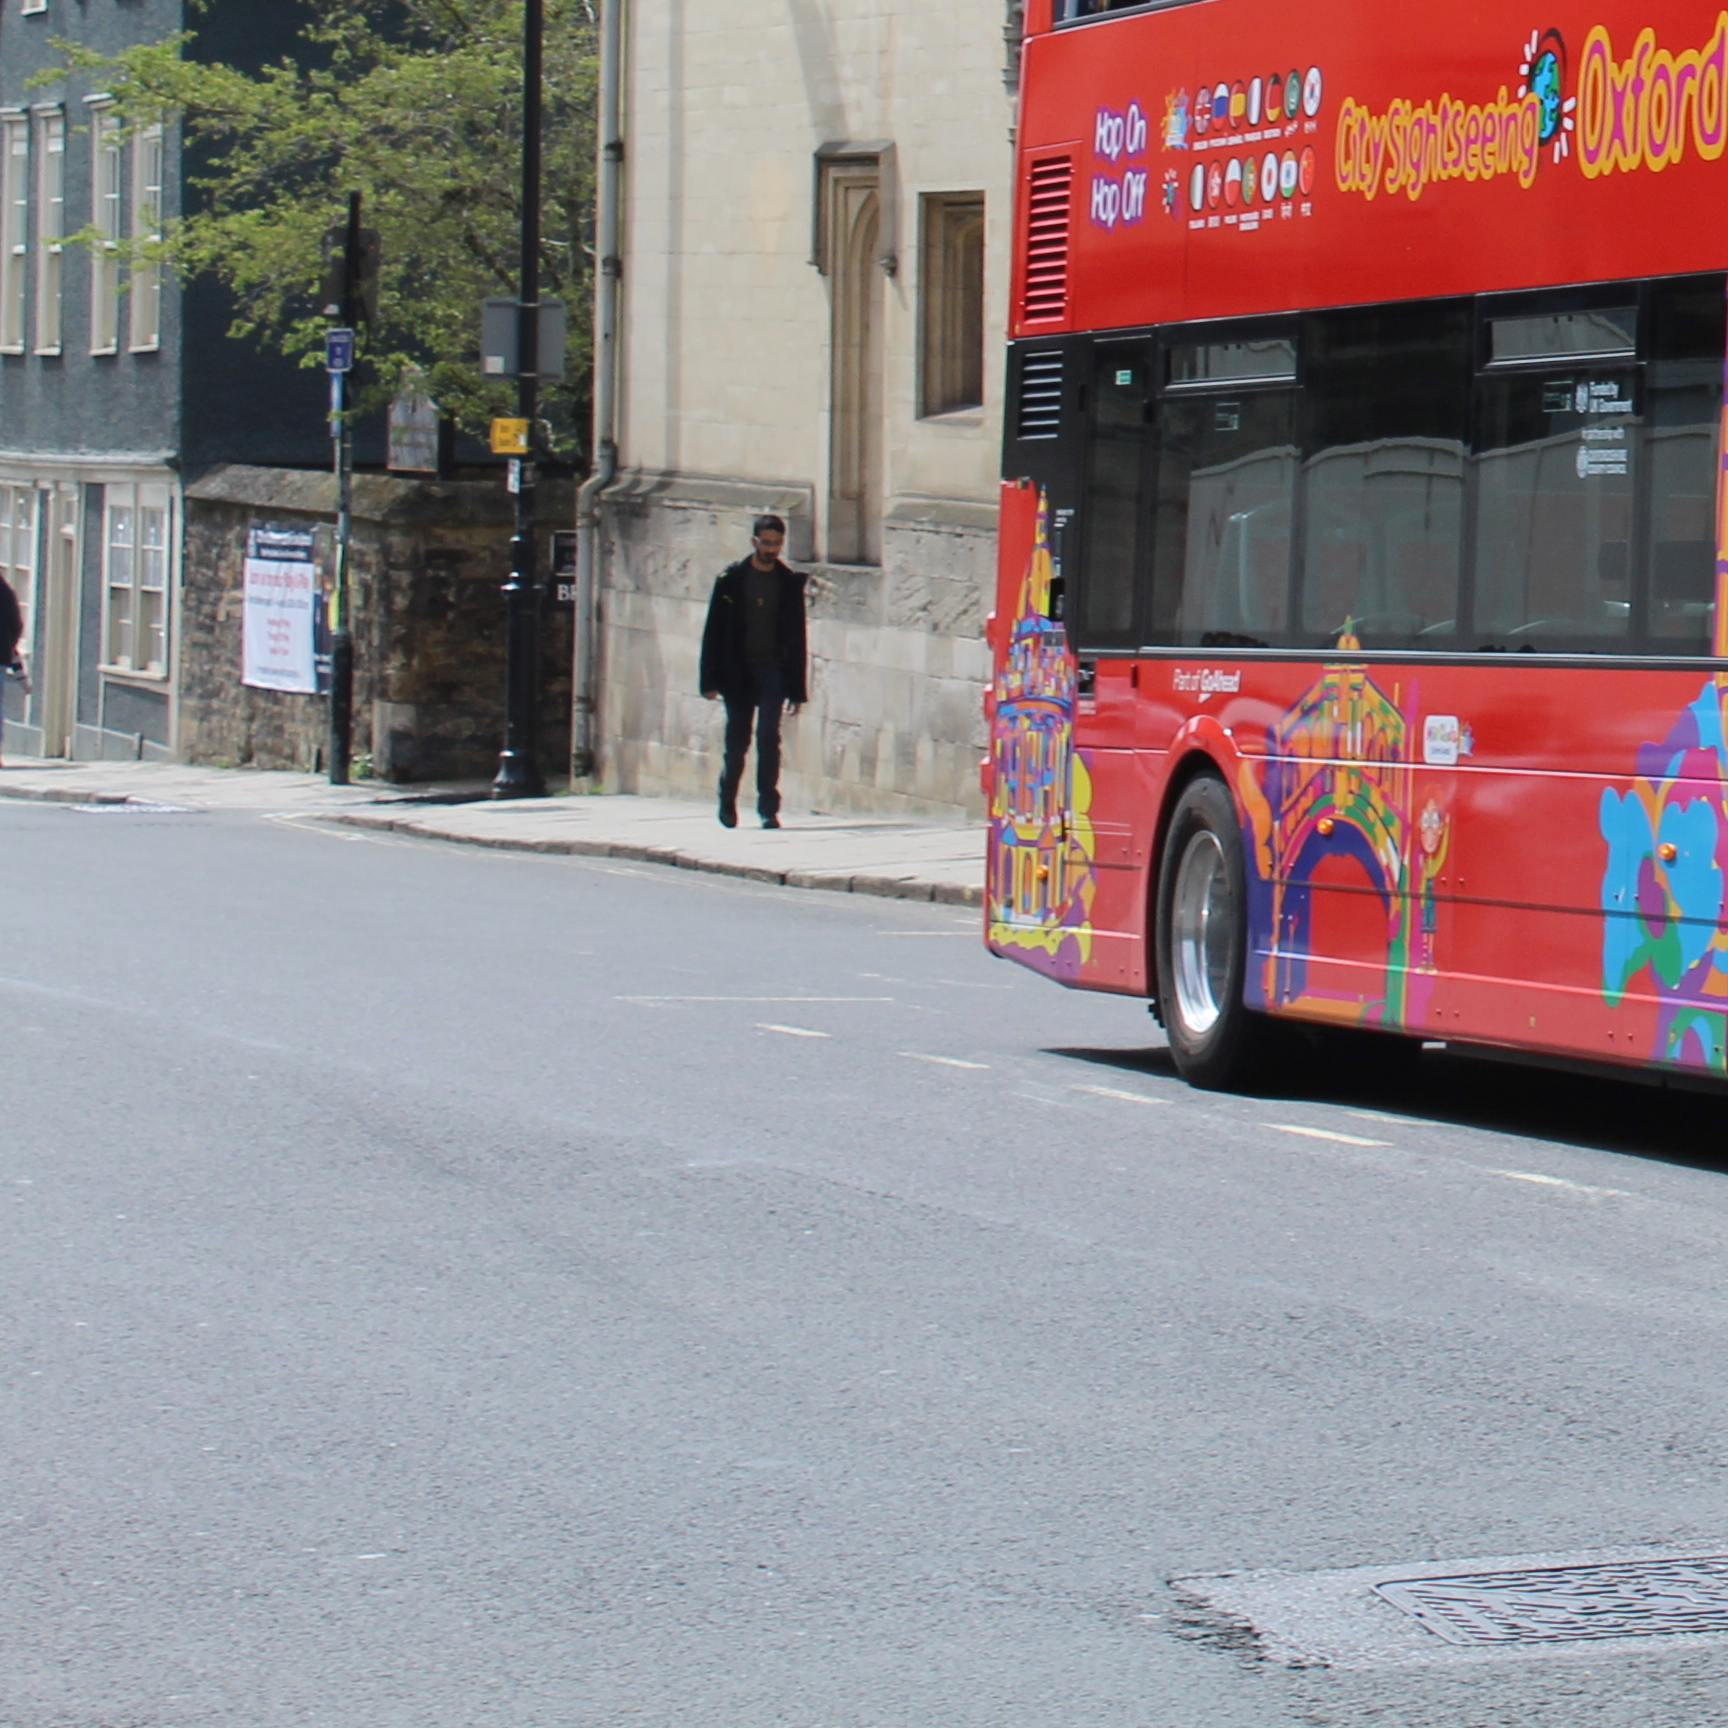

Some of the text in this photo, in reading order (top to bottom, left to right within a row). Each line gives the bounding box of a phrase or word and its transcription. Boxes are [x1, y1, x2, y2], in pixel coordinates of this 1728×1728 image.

[1095, 111, 1124, 161] Hop
[1125, 103, 1147, 154] On
[1091, 177, 1120, 228] Hop
[1122, 171, 1148, 221] Off
